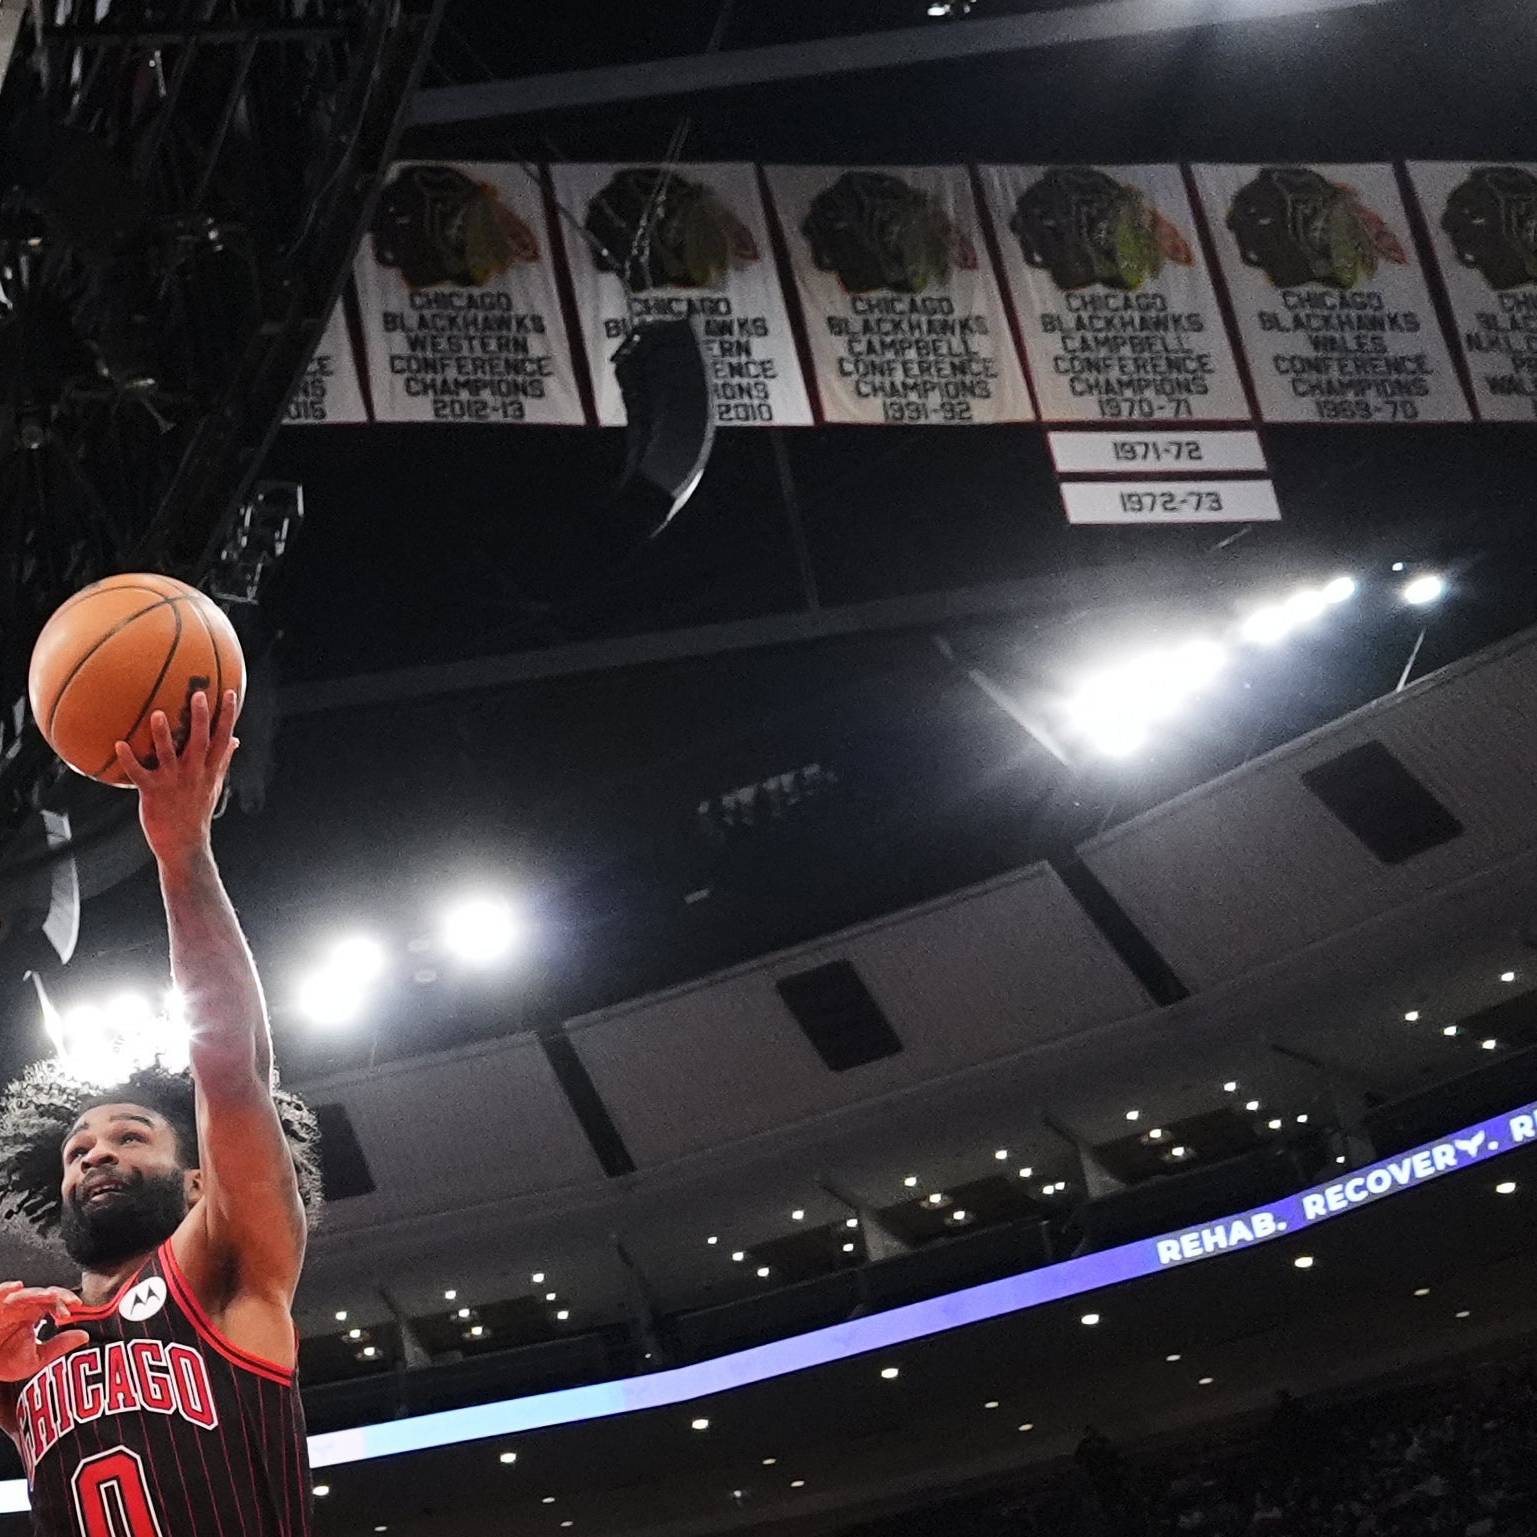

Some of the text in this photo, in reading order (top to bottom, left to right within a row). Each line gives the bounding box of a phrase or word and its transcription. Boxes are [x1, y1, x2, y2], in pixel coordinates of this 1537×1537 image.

[410, 292, 513, 312] CHICAGO
[851, 297, 954, 316] CHICAGO
[1065, 293, 1167, 312] CHICAGO
[1282, 291, 1383, 311] CHICAGO
[383, 313, 545, 333] BLACKHAWKS
[829, 316, 990, 336] BLACKHAWKS
[1041, 313, 1205, 333] BLACKHAWKS
[1258, 311, 1421, 332] BLACKHAWKS
[405, 336, 529, 355] WESTERN
[847, 339, 978, 357] CAMPBELL
[389, 355, 552, 376] CONFERENCE
[838, 358, 998, 378] CONFERENCE
[1053, 354, 1214, 374] CONFERENCE
[405, 378, 545, 397] CHAMPIONS
[854, 380, 991, 399] CHAMPIONS
[1069, 377, 1210, 396] CHAMPIONS
[1113, 440, 1204, 460] 1971-72
[1120, 492, 1223, 511] 1972-73
[1157, 1131, 1499, 1264] REHAB. RECOVERY.
